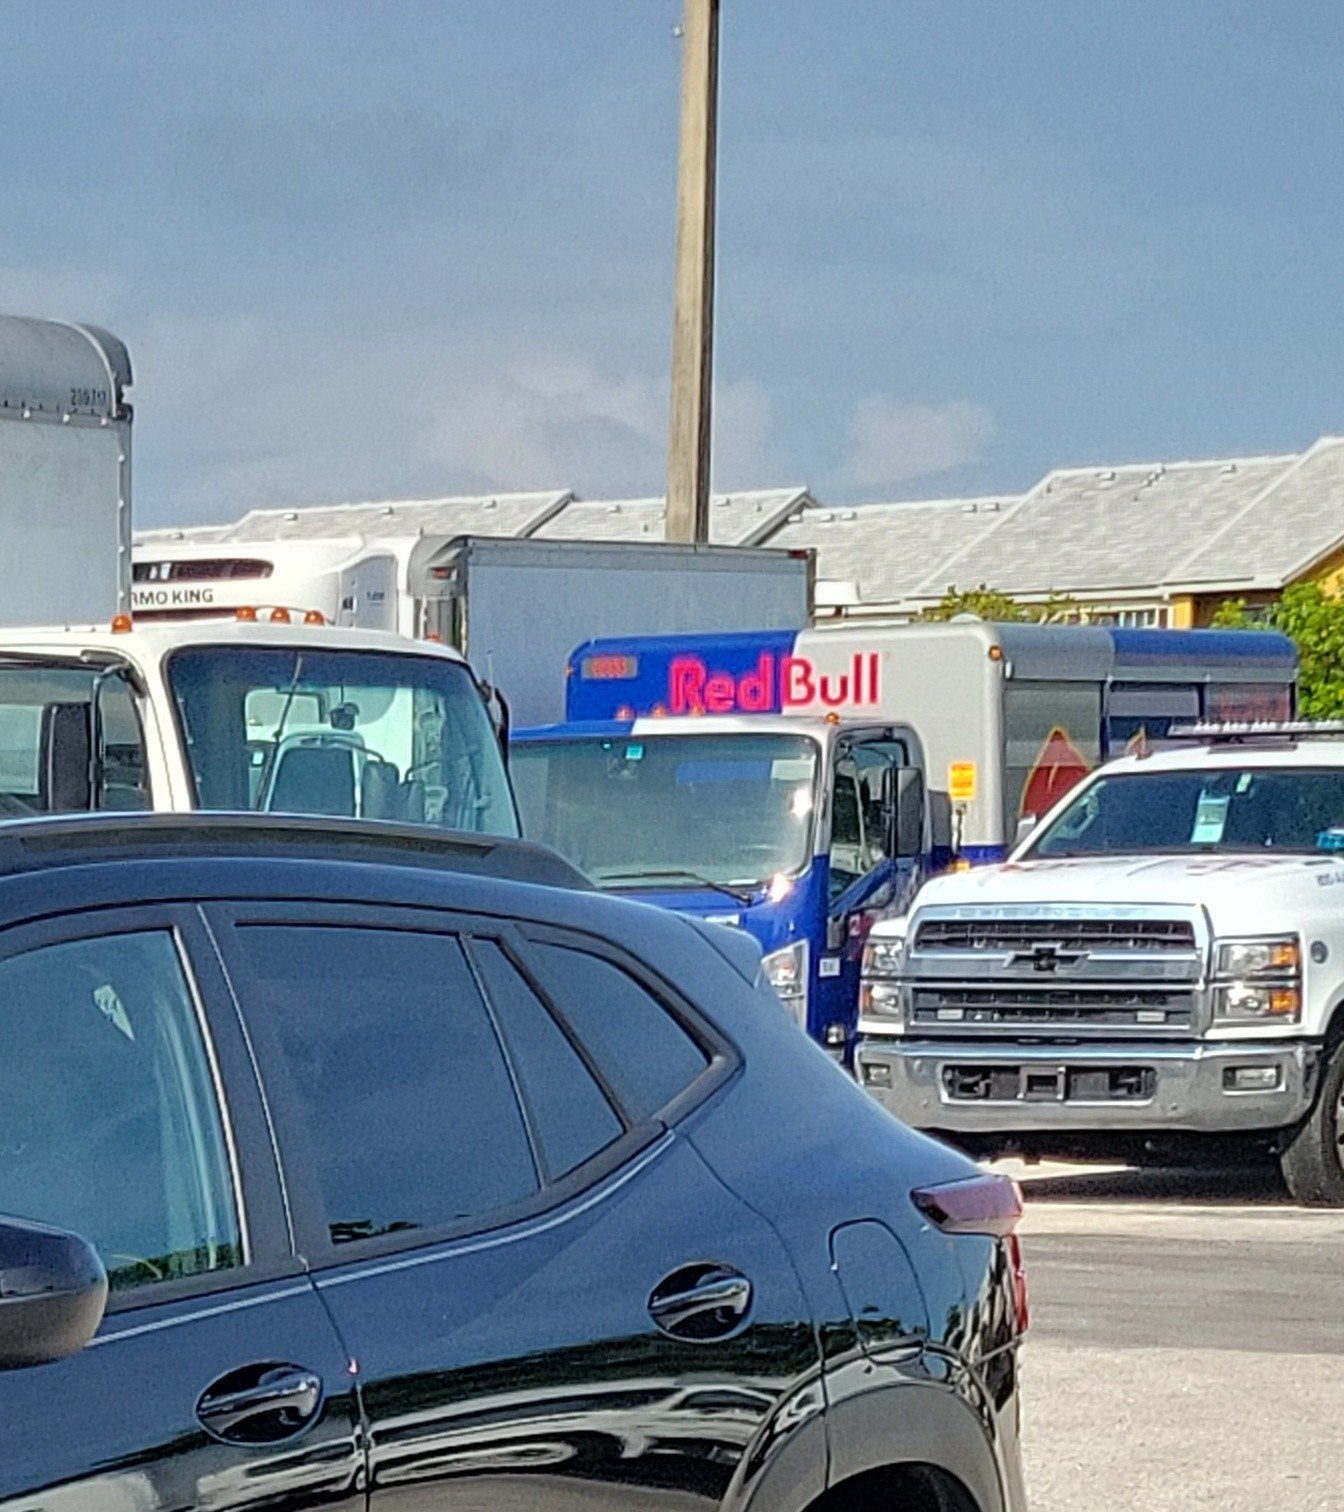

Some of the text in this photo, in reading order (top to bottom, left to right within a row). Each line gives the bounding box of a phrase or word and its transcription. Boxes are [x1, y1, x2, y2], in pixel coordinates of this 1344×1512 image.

[172, 588, 214, 605] KING
[670, 652, 879, 713] Red Bull
